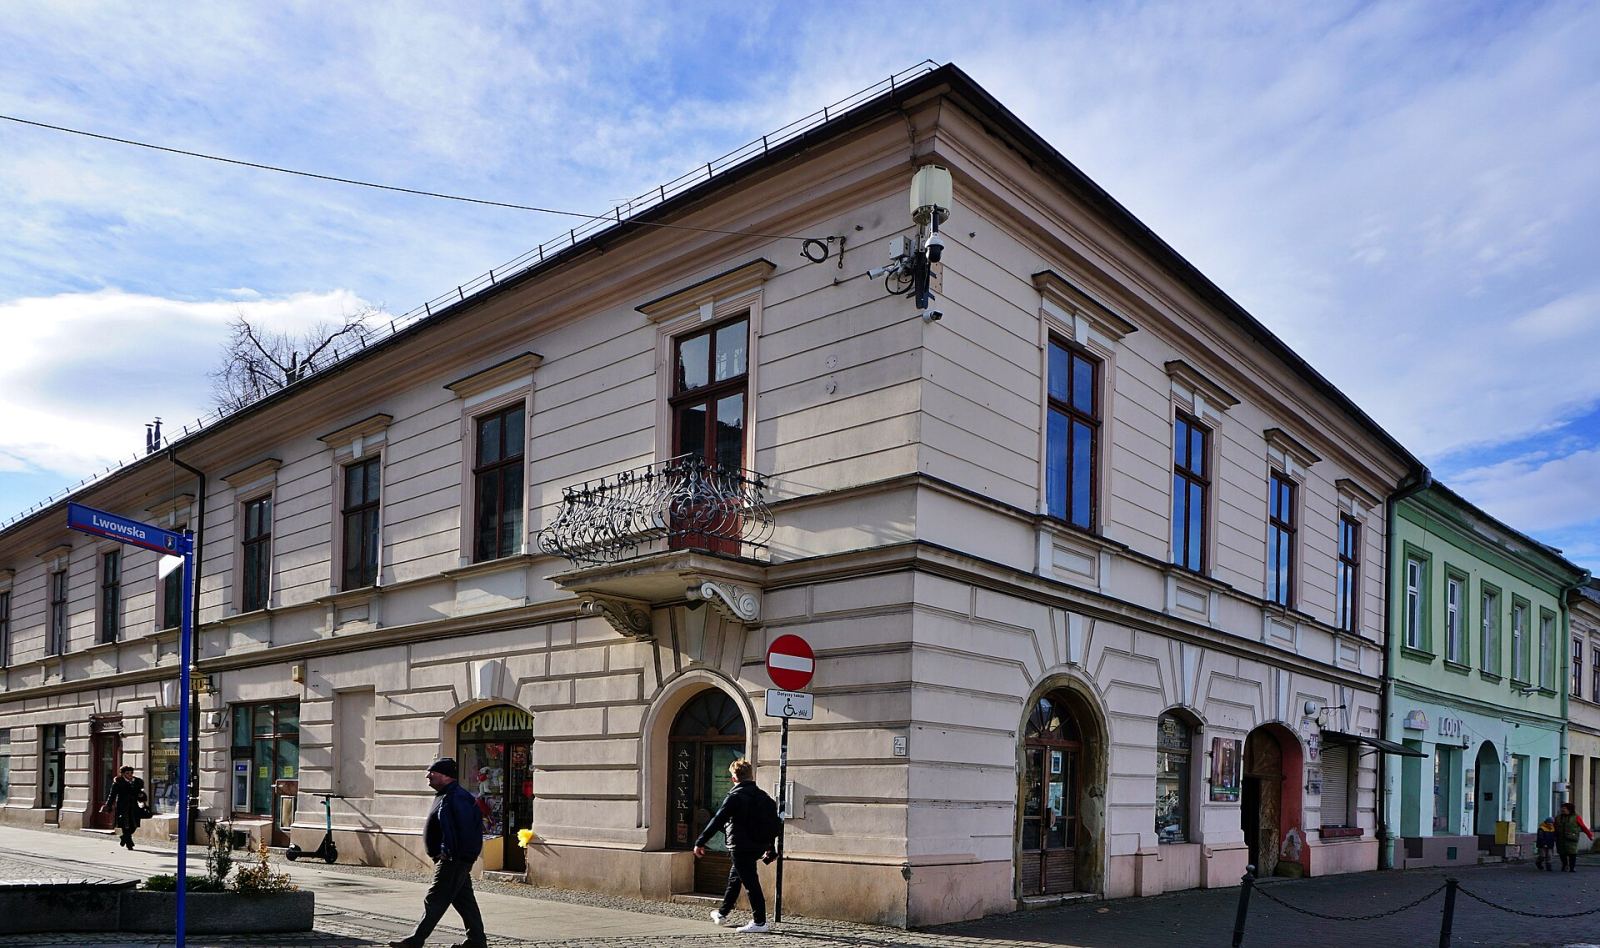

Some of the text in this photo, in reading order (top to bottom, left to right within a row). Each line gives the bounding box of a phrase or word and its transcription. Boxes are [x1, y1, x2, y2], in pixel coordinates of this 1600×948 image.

[92, 514, 146, 540] Lwowska
[460, 709, 534, 733] UPOMIN
[677, 749, 689, 822] ANTYKI
